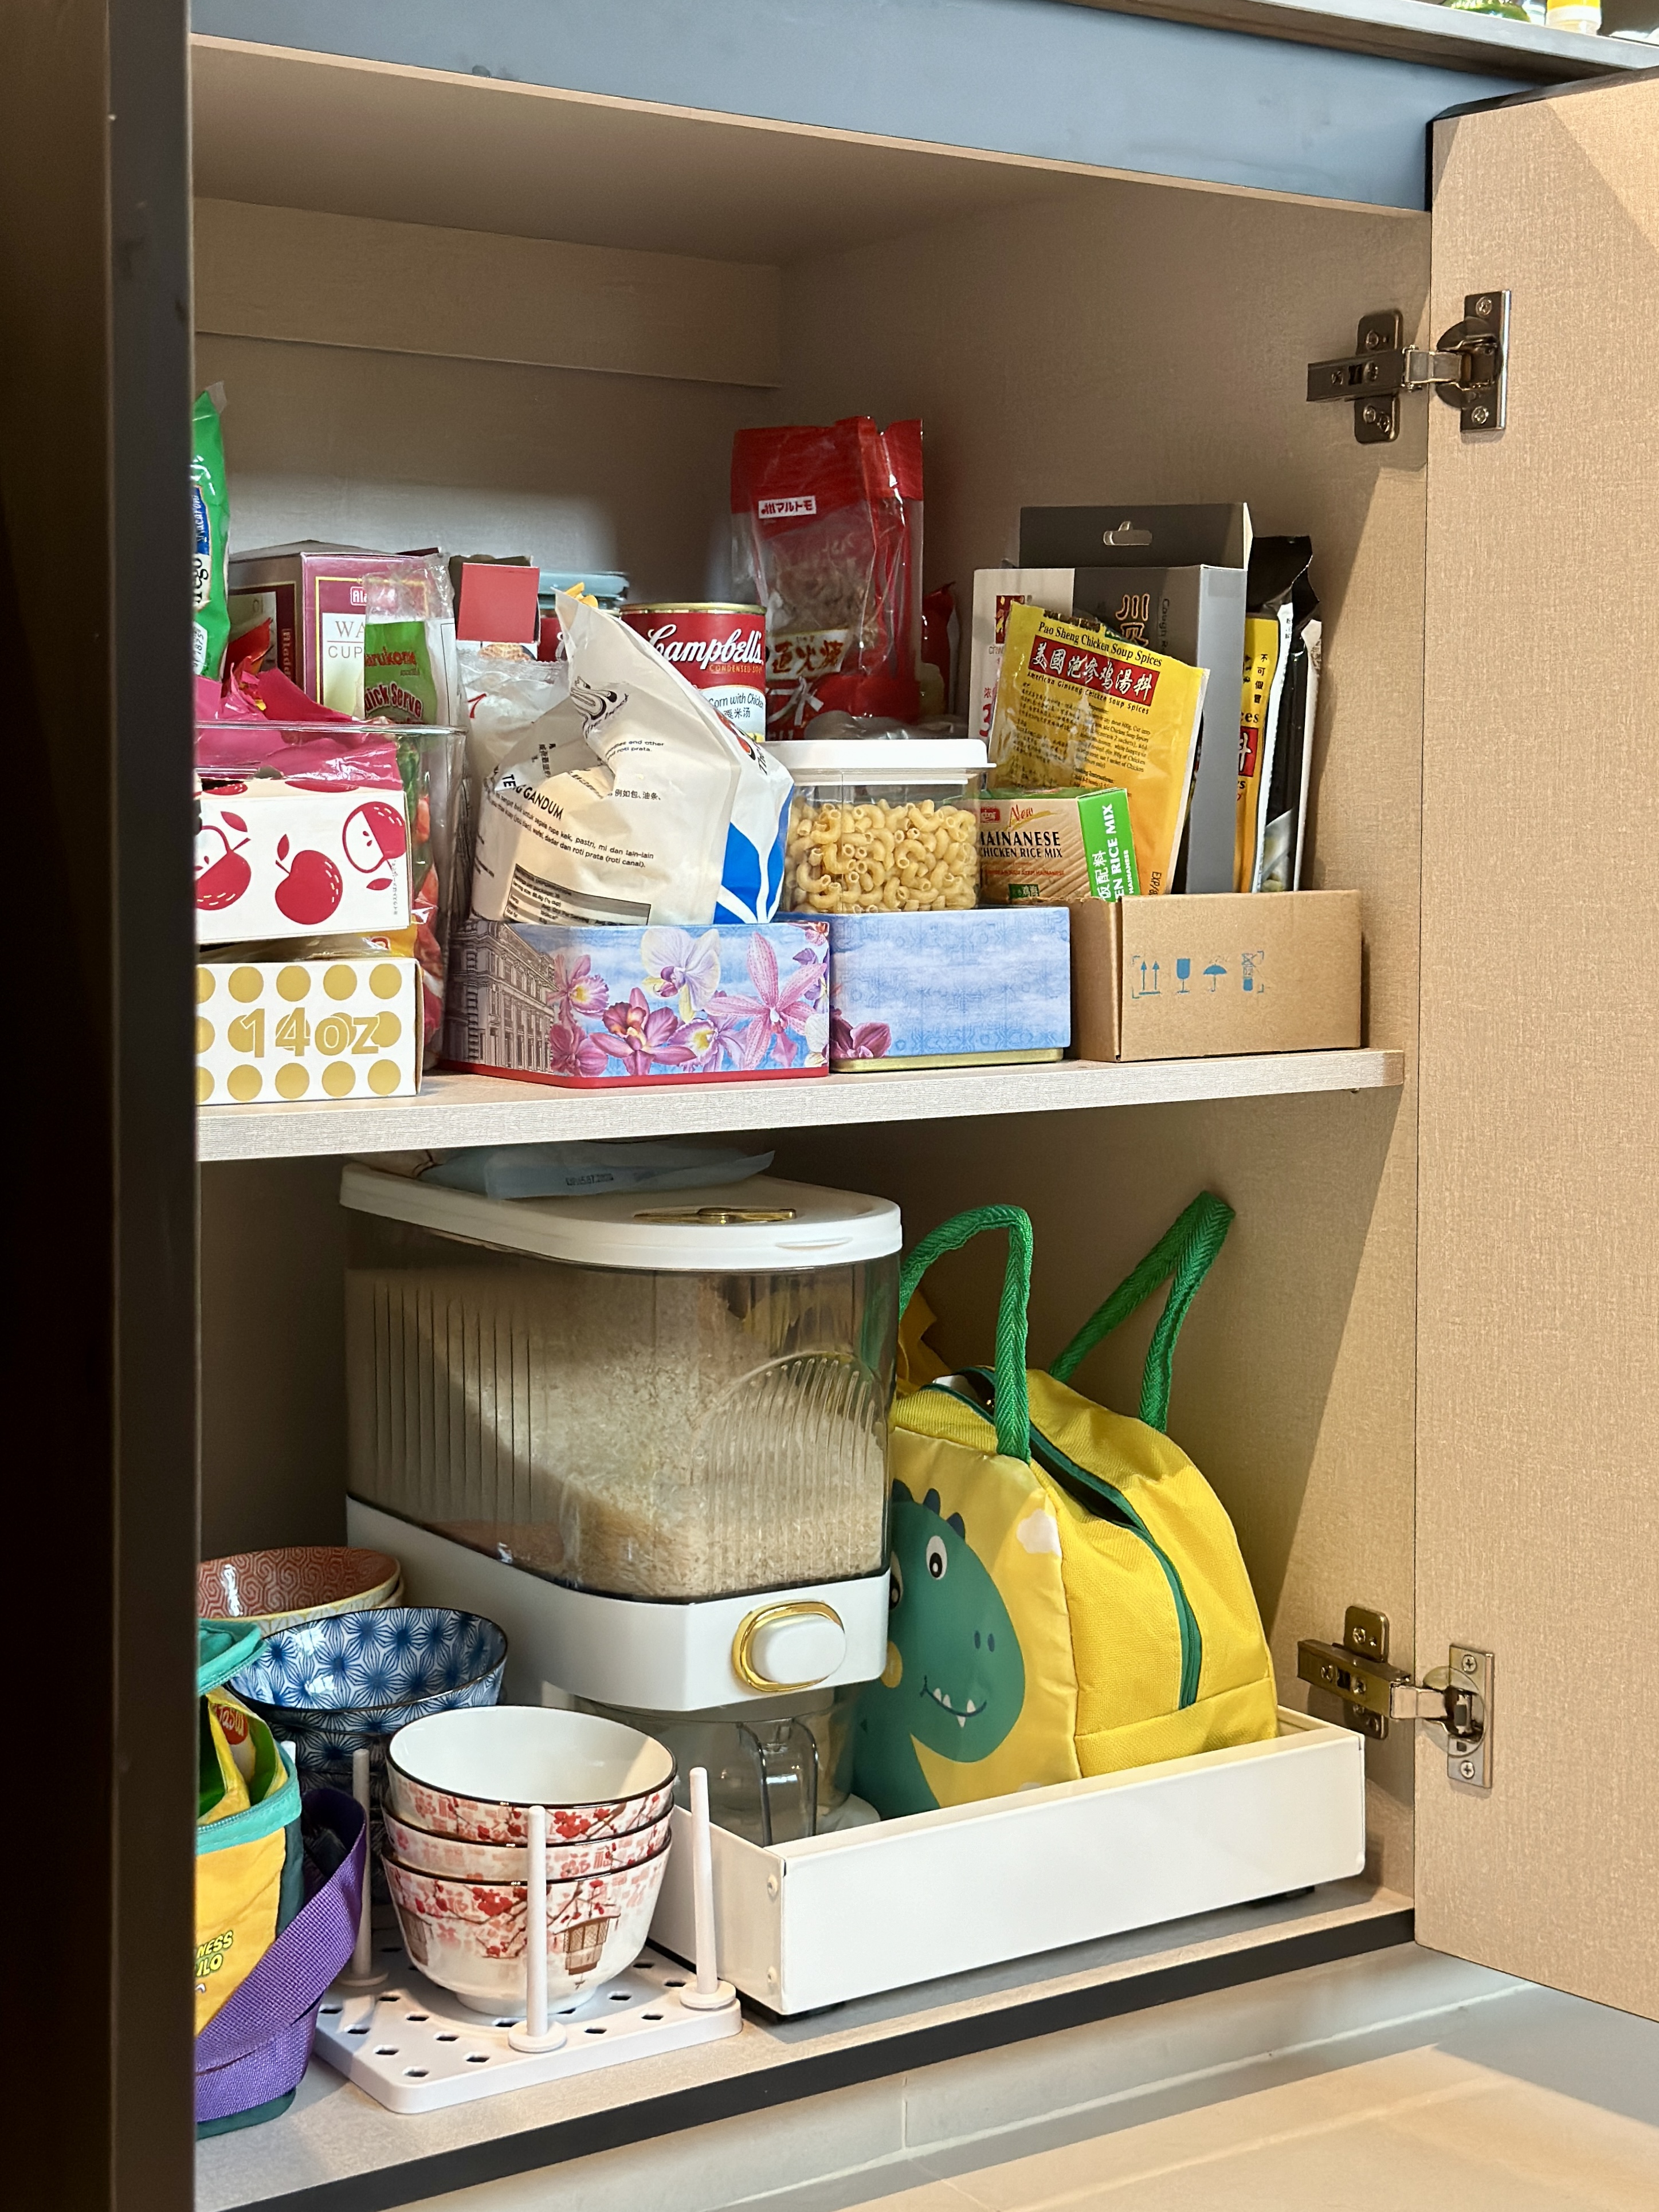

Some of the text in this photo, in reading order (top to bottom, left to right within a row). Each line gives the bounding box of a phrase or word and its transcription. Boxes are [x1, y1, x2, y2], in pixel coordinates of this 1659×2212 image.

[775, 499, 813, 513] マルトモ
[648, 624, 763, 670] Campbell's
[1038, 621, 1054, 636] Pao
[1055, 626, 1080, 646] Sheng
[1081, 634, 1111, 653] Chicken
[1111, 643, 1134, 660] Soup
[1135, 650, 1163, 668] Spices
[709, 665, 750, 673] CONDENSED
[364, 683, 422, 717] uick Serve
[730, 692, 746, 705] with
[1027, 672, 1054, 685] American
[1057, 681, 1083, 695] Ginseng
[1085, 689, 1107, 702] Chicken
[1109, 697, 1125, 709] Soup
[1127, 702, 1150, 715] Spices
[522, 787, 564, 820] GANDUM
[1008, 804, 1034, 828] New
[559, 842, 571, 851] dan
[572, 847, 584, 856] roti
[585, 851, 603, 861] prata
[605, 855, 621, 865] (roti
[575, 837, 596, 849] pastri,
[610, 847, 623, 855] dan
[625, 850, 654, 859] lain-lain
[1020, 848, 1041, 858] RICE
[1045, 848, 1062, 858] MIX
[1101, 803, 1125, 902] EN RICE MIX
[1123, 850, 1134, 894] HAINANESE
[240, 1007, 379, 1058] 14oz
[197, 1930, 233, 1959] NESS
[196, 1953, 223, 1977] ILO
